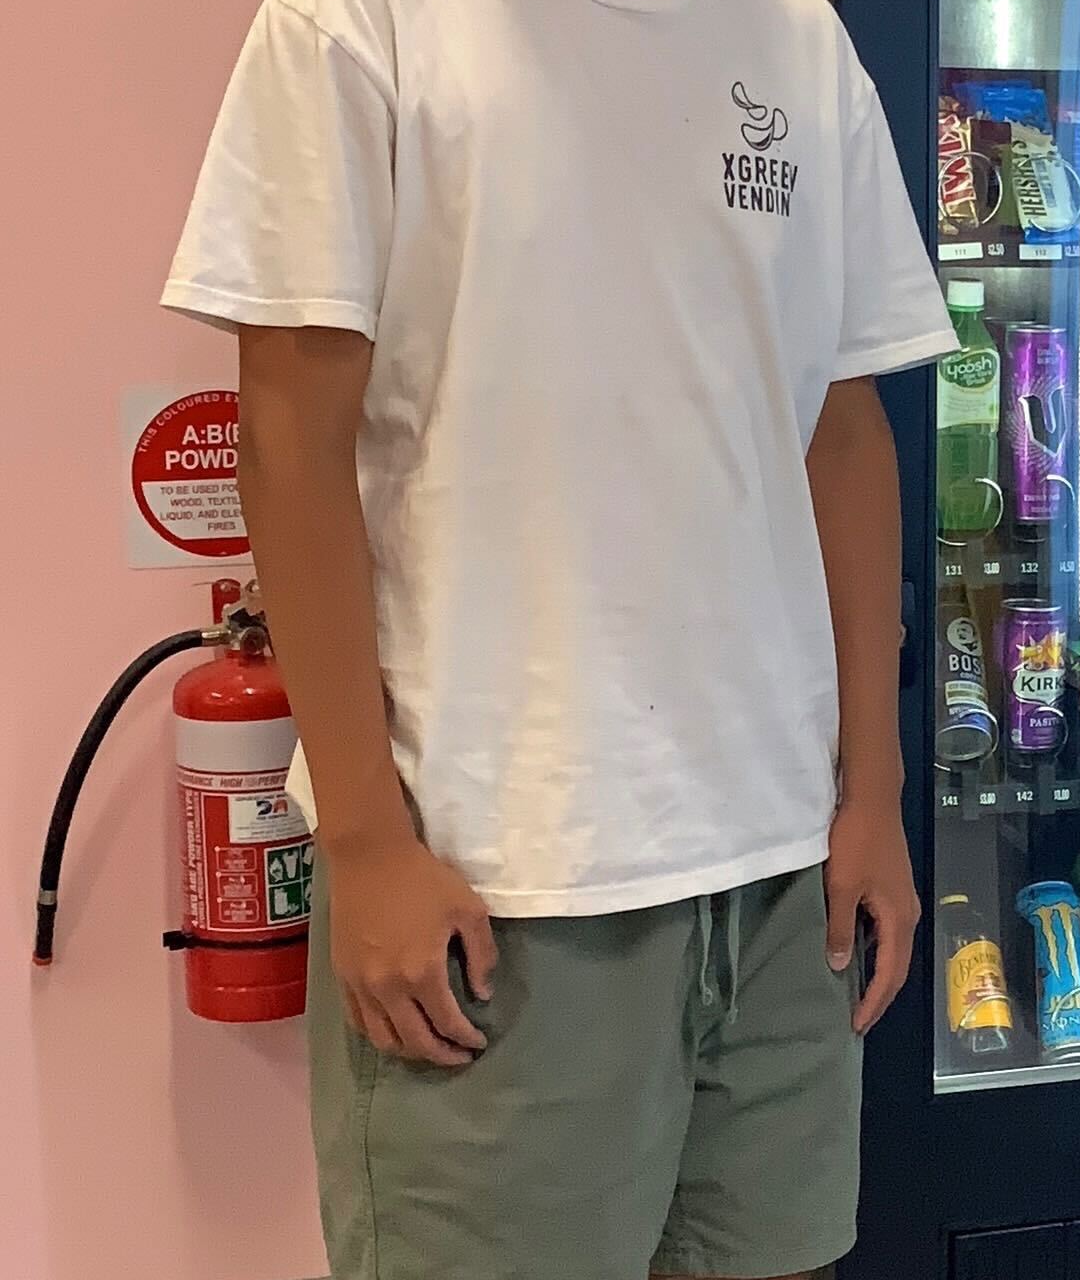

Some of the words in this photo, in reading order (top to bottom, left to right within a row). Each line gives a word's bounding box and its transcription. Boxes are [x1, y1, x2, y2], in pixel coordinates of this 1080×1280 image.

[724, 182, 791, 217] VENDIN
[138, 428, 157, 453] THIS
[156, 393, 220, 427] COLOURED
[165, 449, 238, 470] POWD
[160, 486, 173, 495] TO
[176, 485, 190, 495] BE
[192, 484, 219, 494] USED
[207, 496, 241, 506] TEXTIL
[198, 509, 219, 519] AND
[207, 522, 236, 531] FIRES
[945, 564, 963, 575] 131
[1021, 563, 1039, 573] 132
[942, 796, 959, 806] 141
[1016, 791, 1034, 802] 142
[186, 821, 196, 868] POWDER
